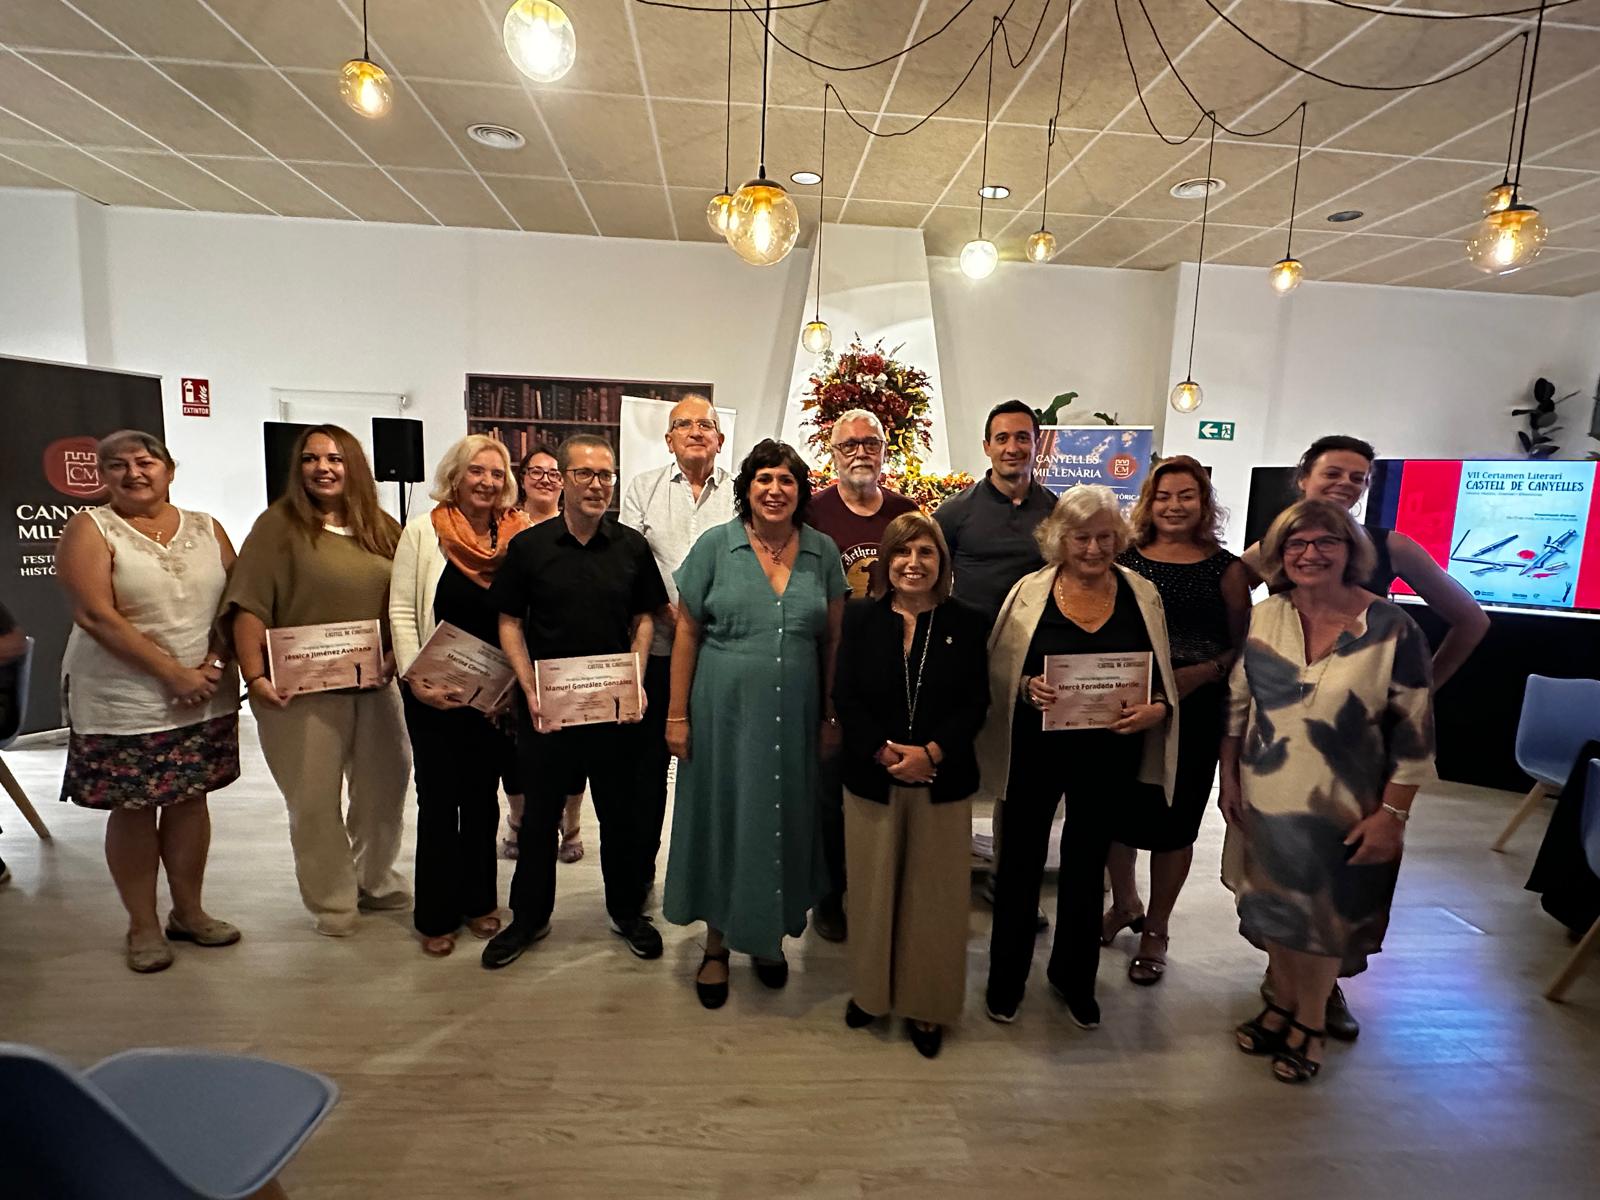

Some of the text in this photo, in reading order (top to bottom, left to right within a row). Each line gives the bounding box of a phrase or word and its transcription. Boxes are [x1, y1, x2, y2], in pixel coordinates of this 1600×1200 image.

[183, 406, 209, 415] EXTINTOR
[1035, 454, 1100, 465] CANYELLES
[69, 466, 99, 481] CM
[1467, 471, 1563, 480] VII Certamen Literari
[1465, 480, 1584, 492] CASTELL DE CANYELLES
[844, 546, 877, 566] Jethro
[545, 683, 571, 692] Manuel
[572, 681, 602, 690] González
[1081, 682, 1114, 690] Foradada
